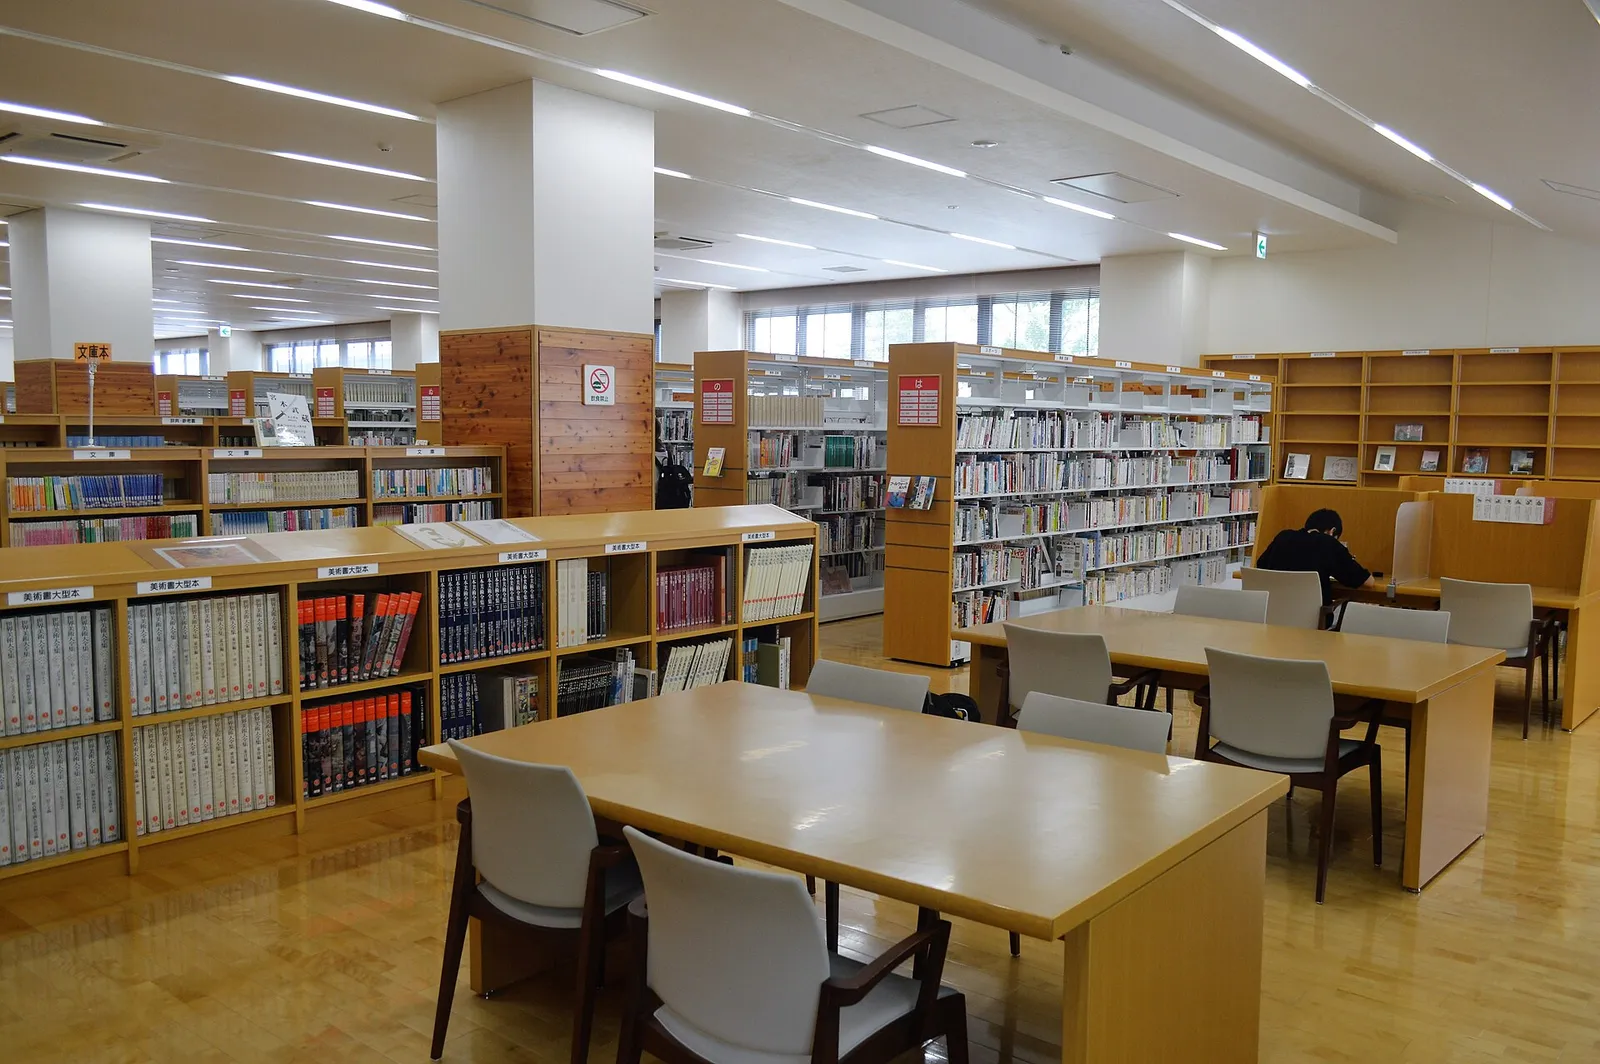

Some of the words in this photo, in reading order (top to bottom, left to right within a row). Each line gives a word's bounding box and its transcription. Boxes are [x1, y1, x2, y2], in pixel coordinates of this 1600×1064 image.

[77, 344, 110, 360] 文庫本
[713, 382, 721, 391] の
[914, 379, 923, 389] は
[507, 551, 539, 561] 美術書大型本
[328, 566, 369, 576] 美術書大型本
[150, 579, 200, 591] 美術書大型本
[23, 589, 80, 602] 美術書大型本
